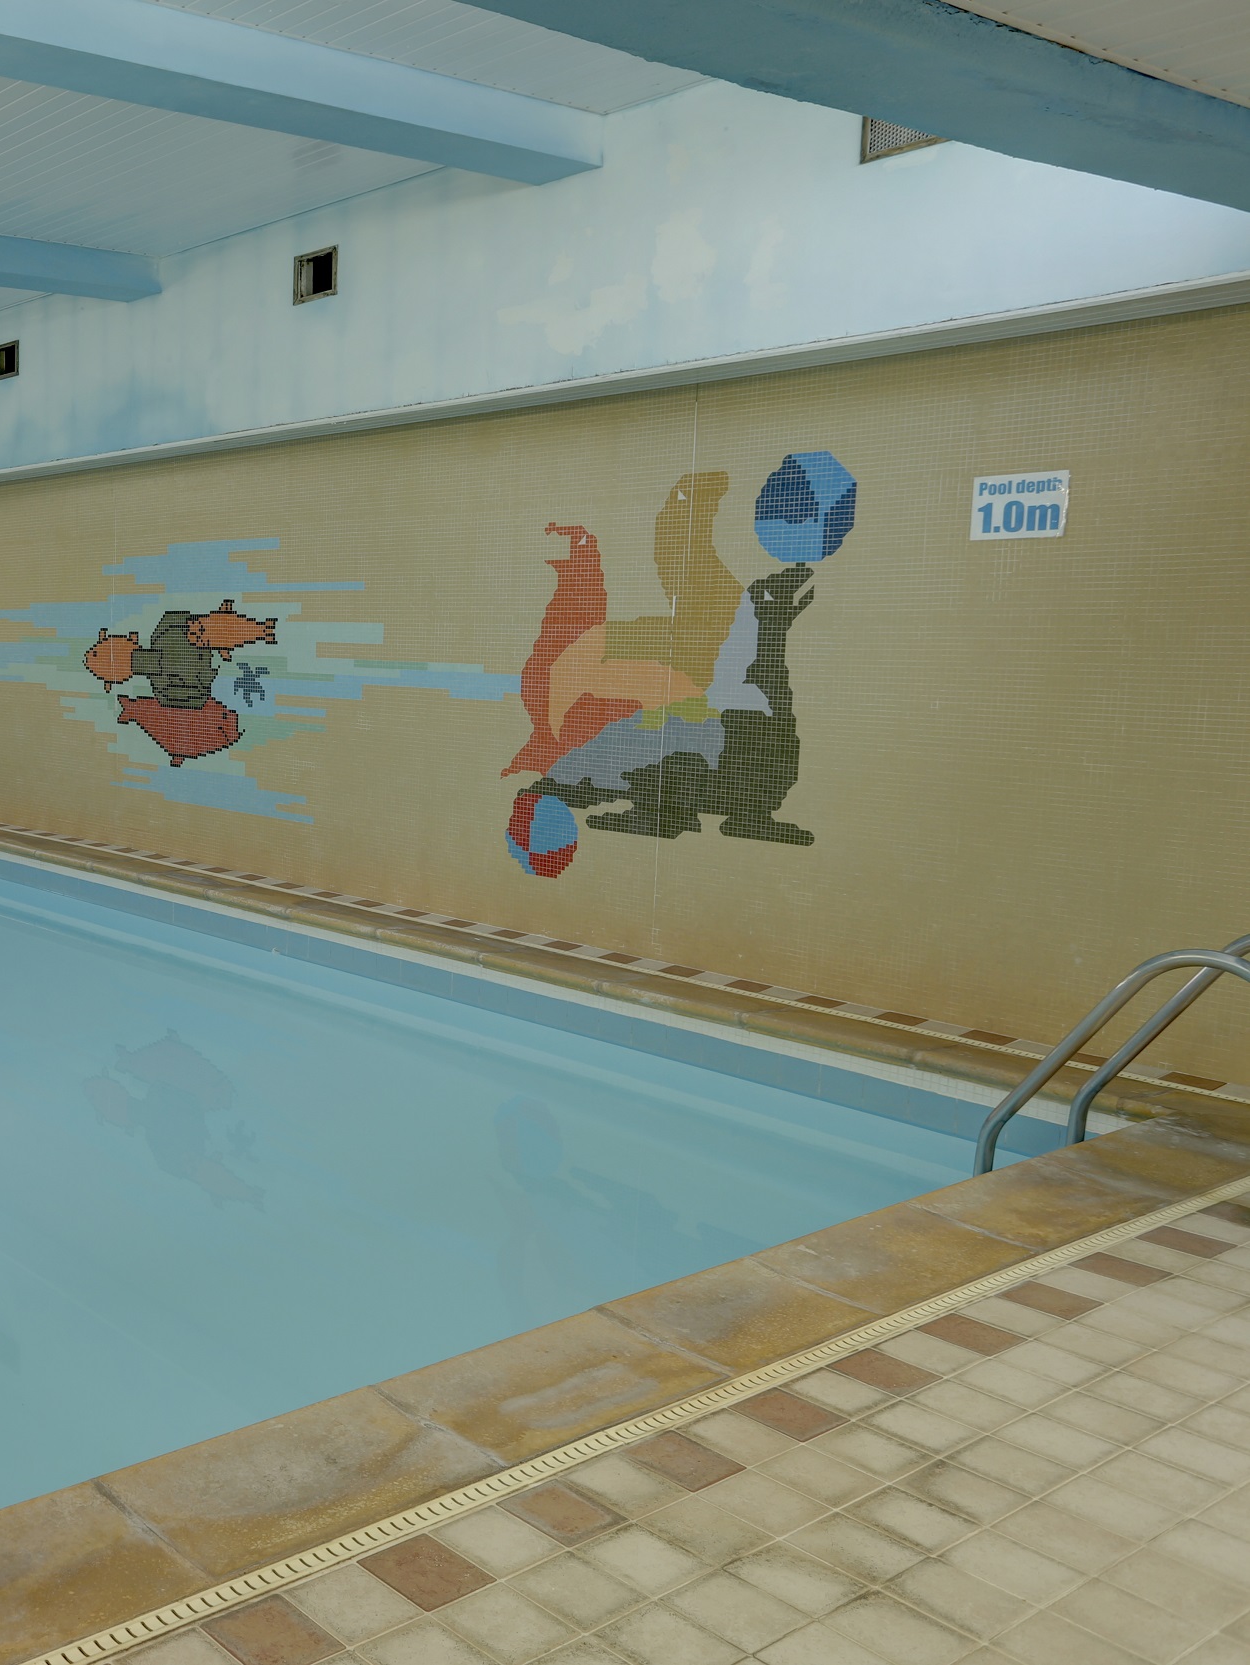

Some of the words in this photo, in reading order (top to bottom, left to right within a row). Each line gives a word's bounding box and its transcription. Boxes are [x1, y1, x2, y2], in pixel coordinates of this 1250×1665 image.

[978, 481, 1012, 496] Pool
[1016, 477, 1063, 494] depth
[977, 500, 1060, 533] 1.0m
